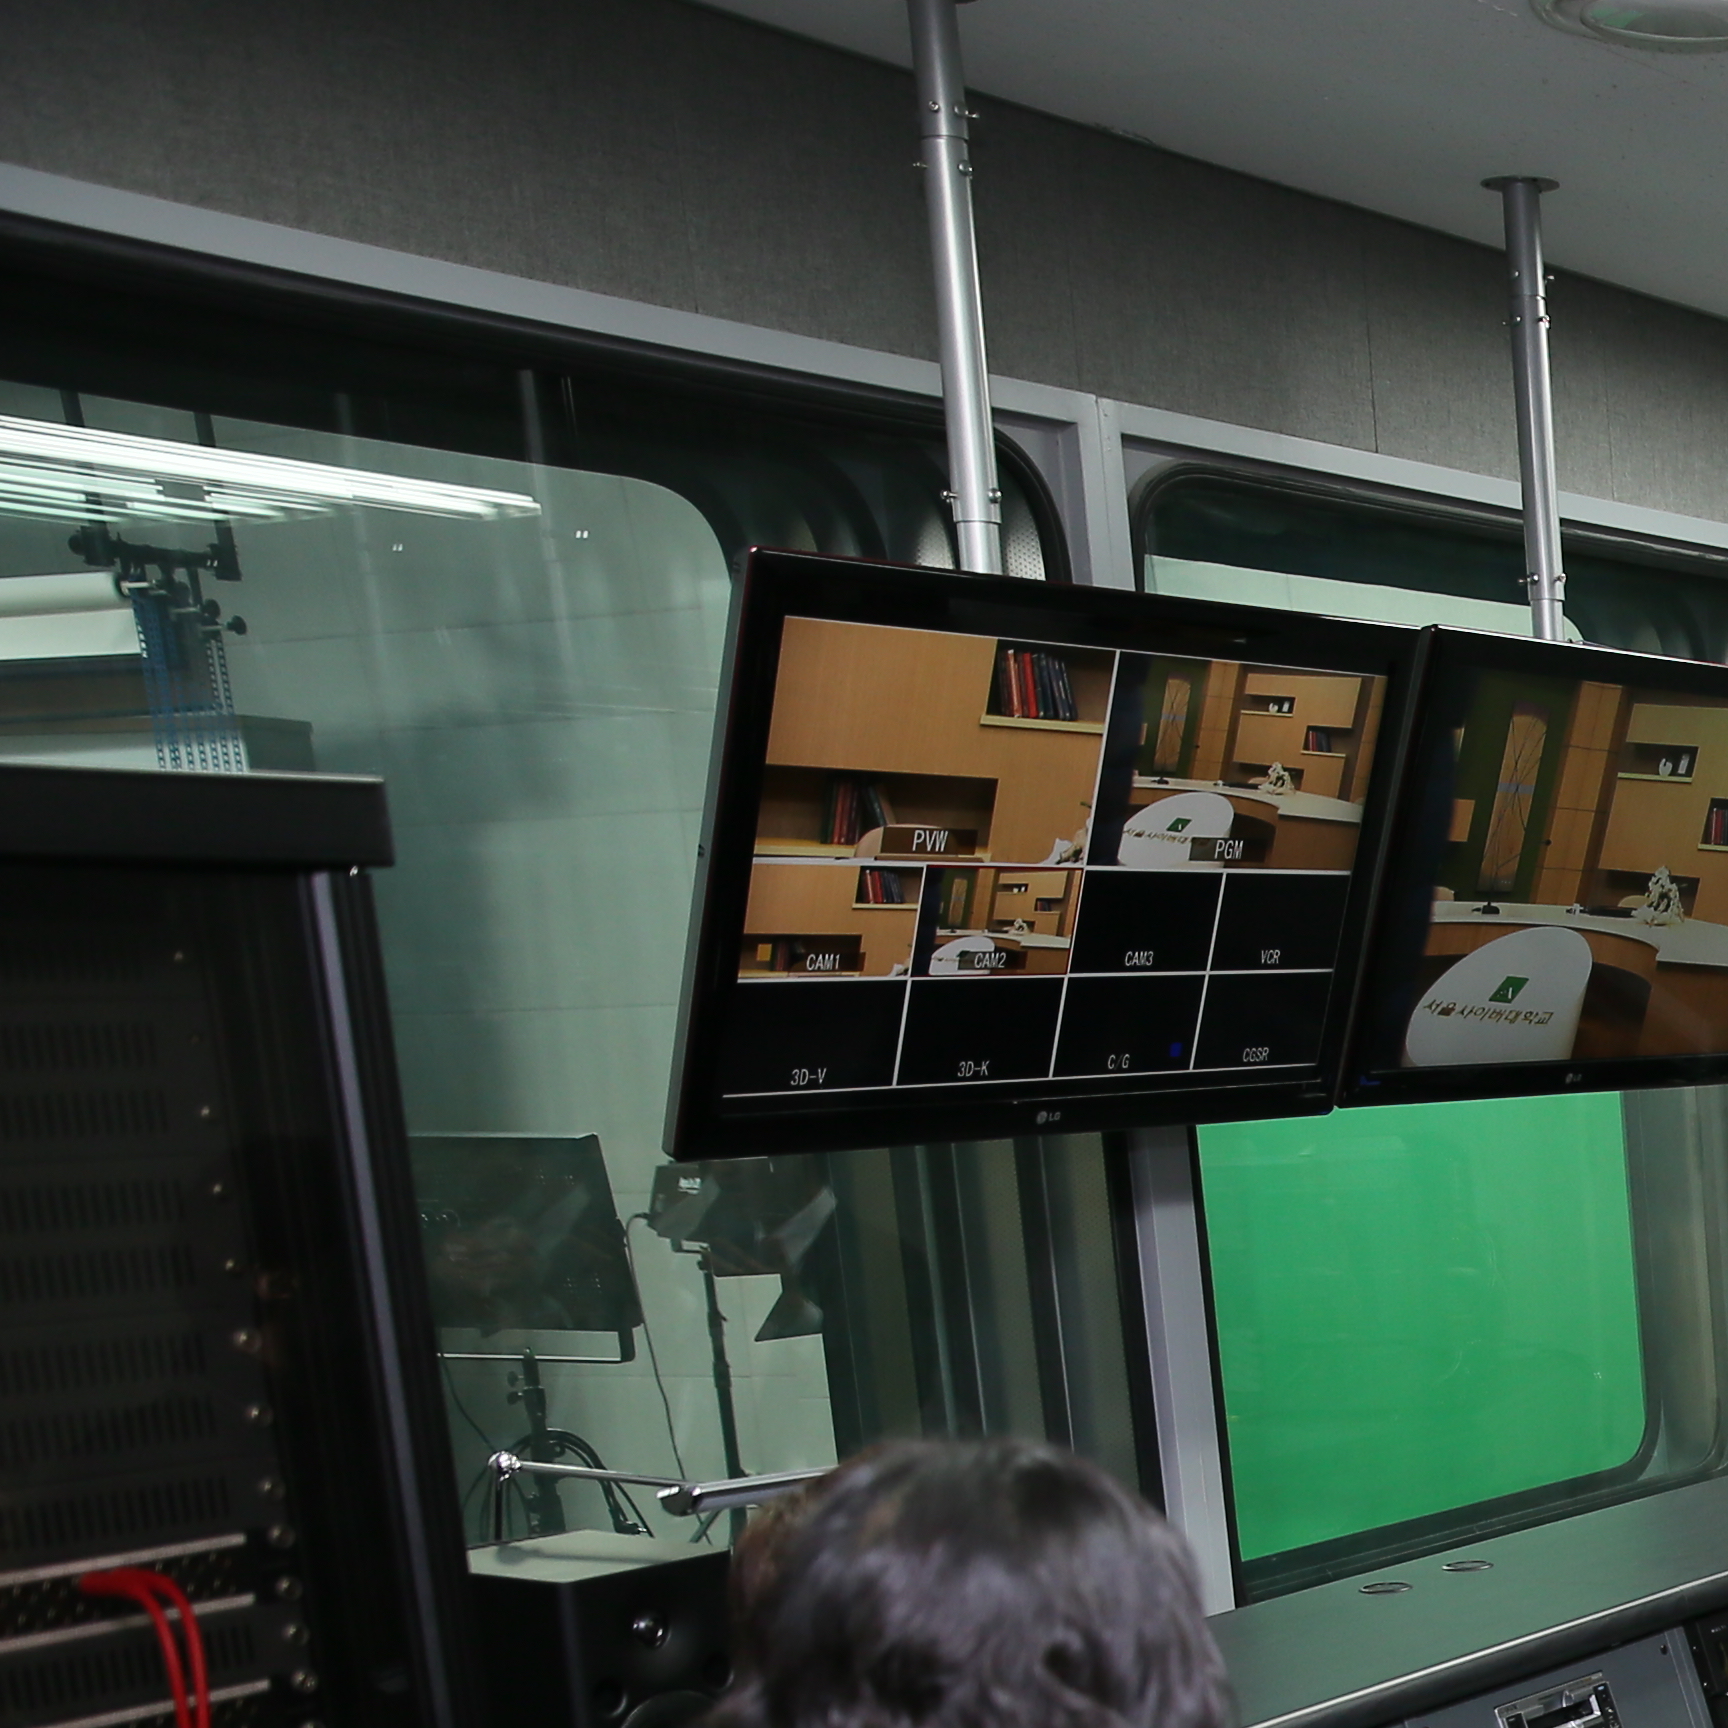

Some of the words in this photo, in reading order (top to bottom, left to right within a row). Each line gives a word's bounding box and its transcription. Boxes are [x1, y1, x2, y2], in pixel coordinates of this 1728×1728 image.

[912, 829, 949, 852] PVW
[1214, 840, 1244, 859] PGM
[806, 953, 841, 971] CAM1
[974, 952, 1007, 969] CAM2
[1124, 951, 1154, 967] CAM3
[1260, 949, 1281, 964] VCR
[1107, 1053, 1131, 1070] C/G
[1242, 1047, 1270, 1063] CGSR
[790, 1068, 827, 1086] 3D-V
[957, 1060, 990, 1077] 3D-K
